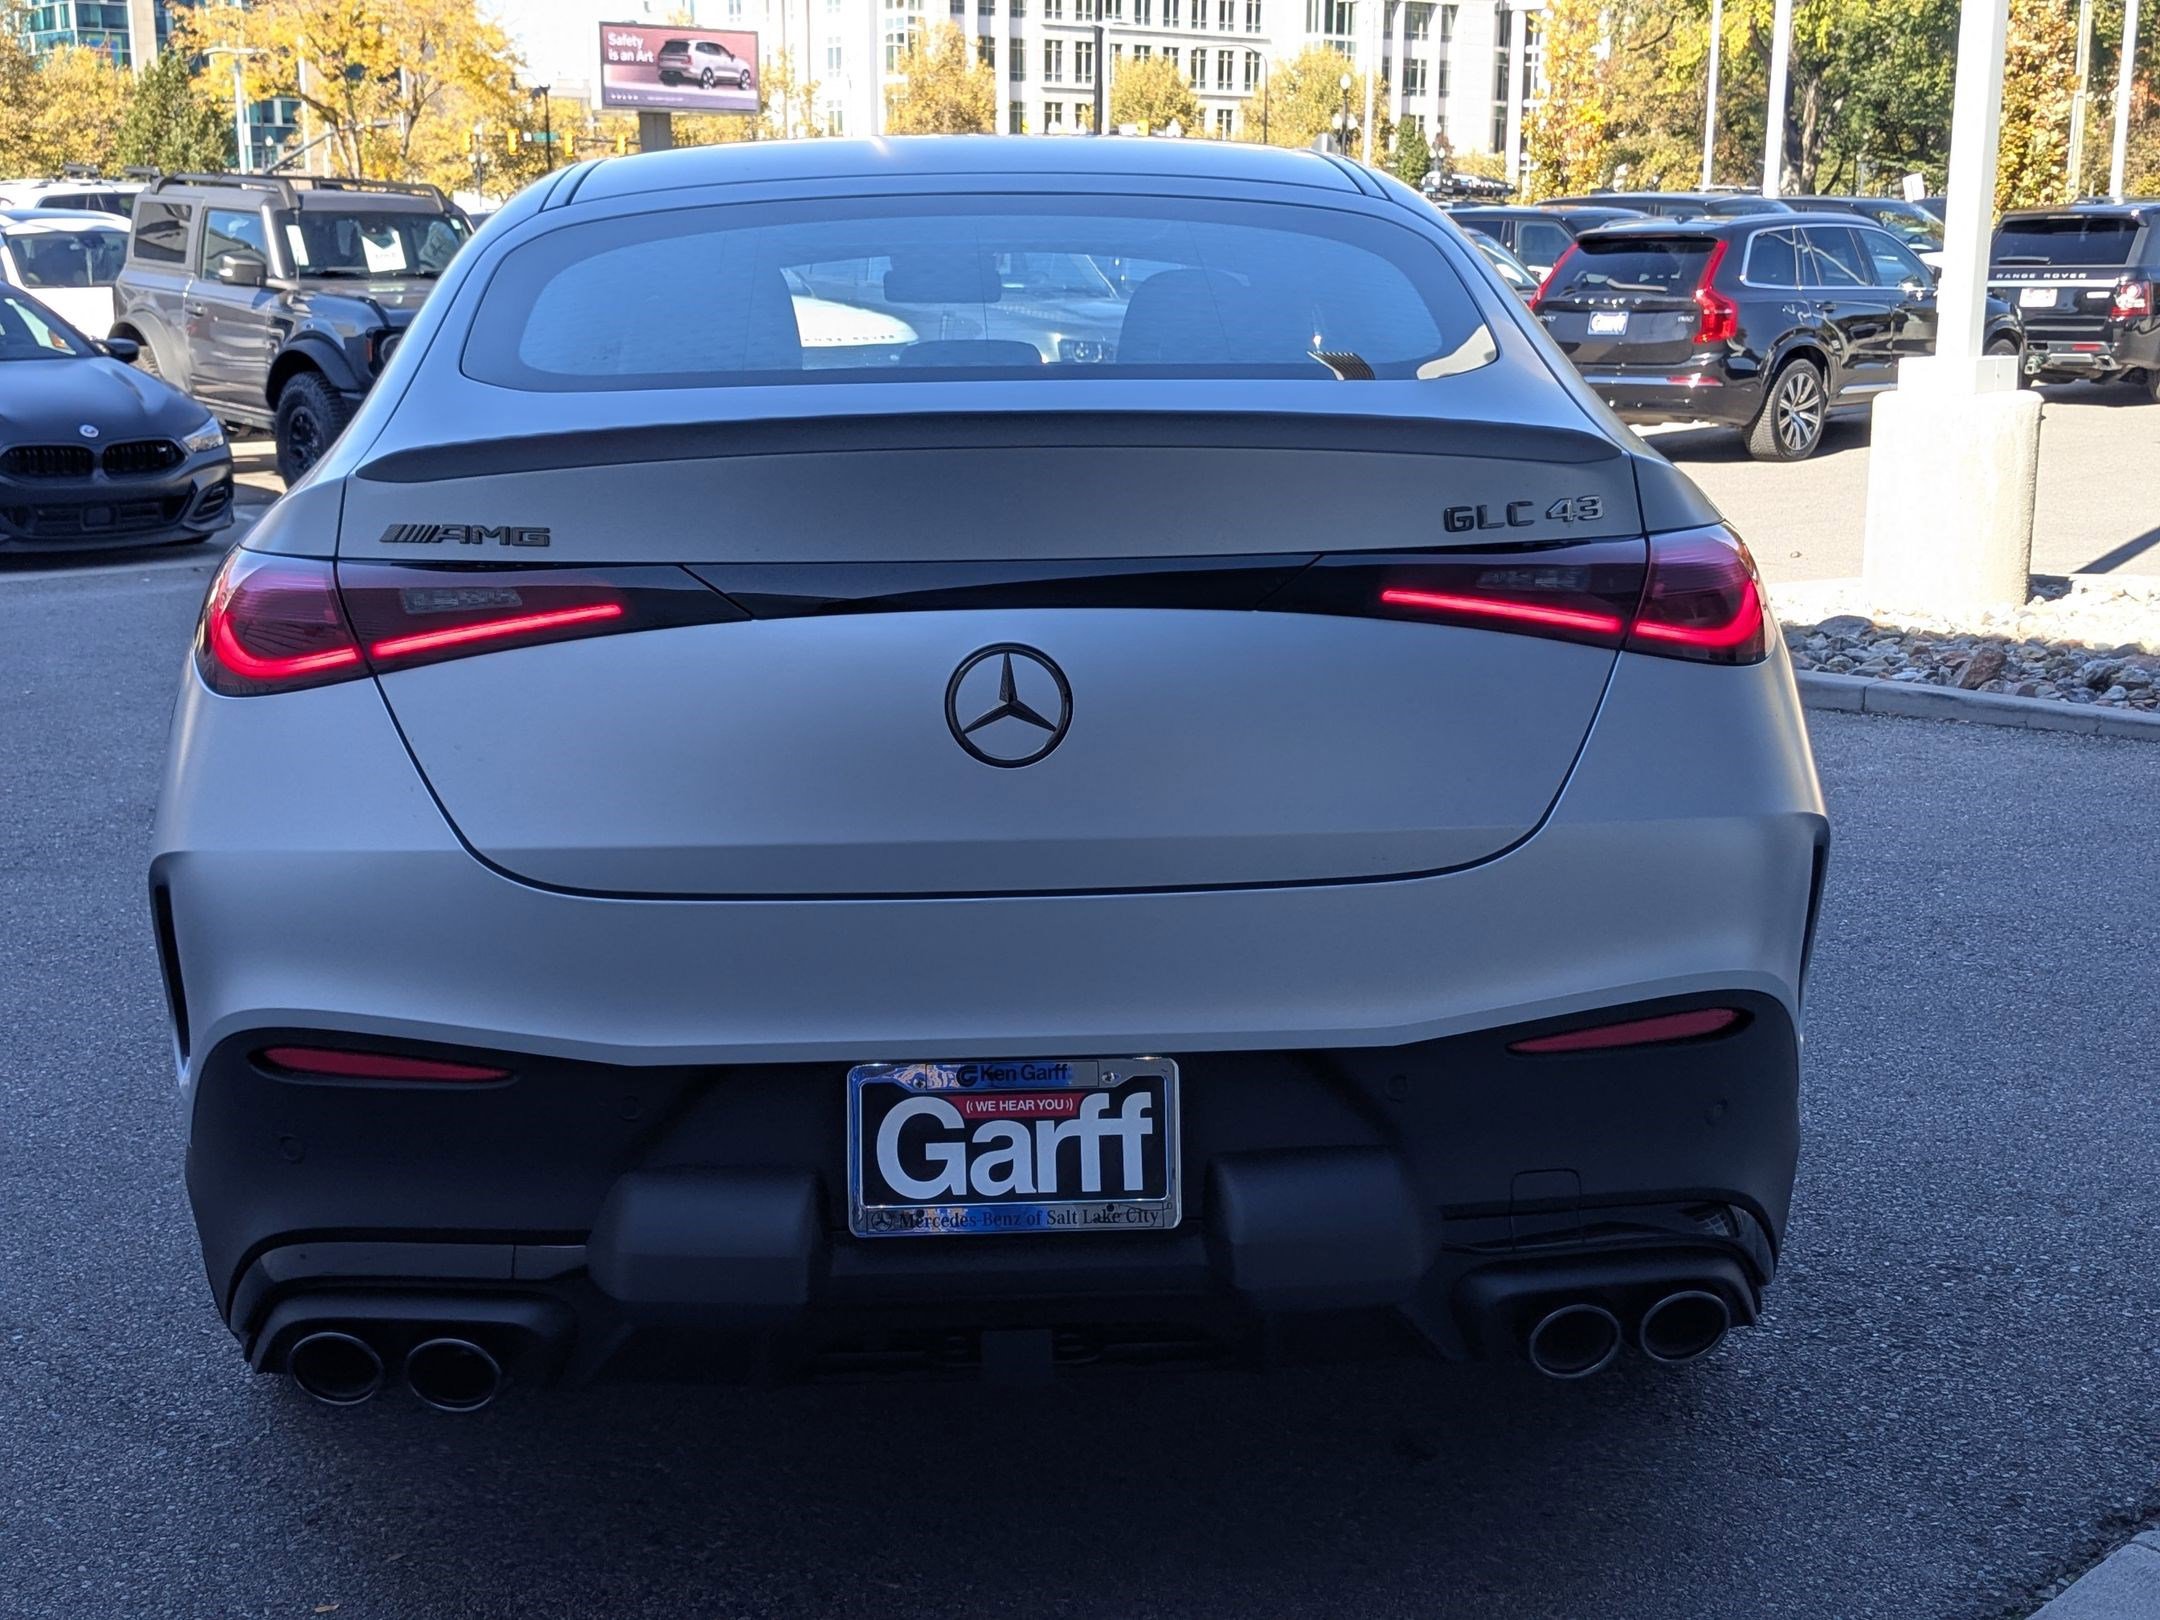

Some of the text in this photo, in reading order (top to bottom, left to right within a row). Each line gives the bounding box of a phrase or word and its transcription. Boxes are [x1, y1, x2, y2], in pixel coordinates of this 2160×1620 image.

[608, 32, 643, 49] Safety
[620, 51, 634, 61] an
[636, 49, 654, 63] Art
[1443, 495, 1604, 533] GLC 43
[430, 524, 551, 547] AMG
[981, 1065, 1017, 1081] Ken
[1021, 1064, 1068, 1081] Garff
[976, 1099, 1064, 1111] WE HEAR YOU
[876, 1091, 1152, 1200] Garff
[899, 1204, 1159, 1229] Mercedes-Benz of Salt Lake City
